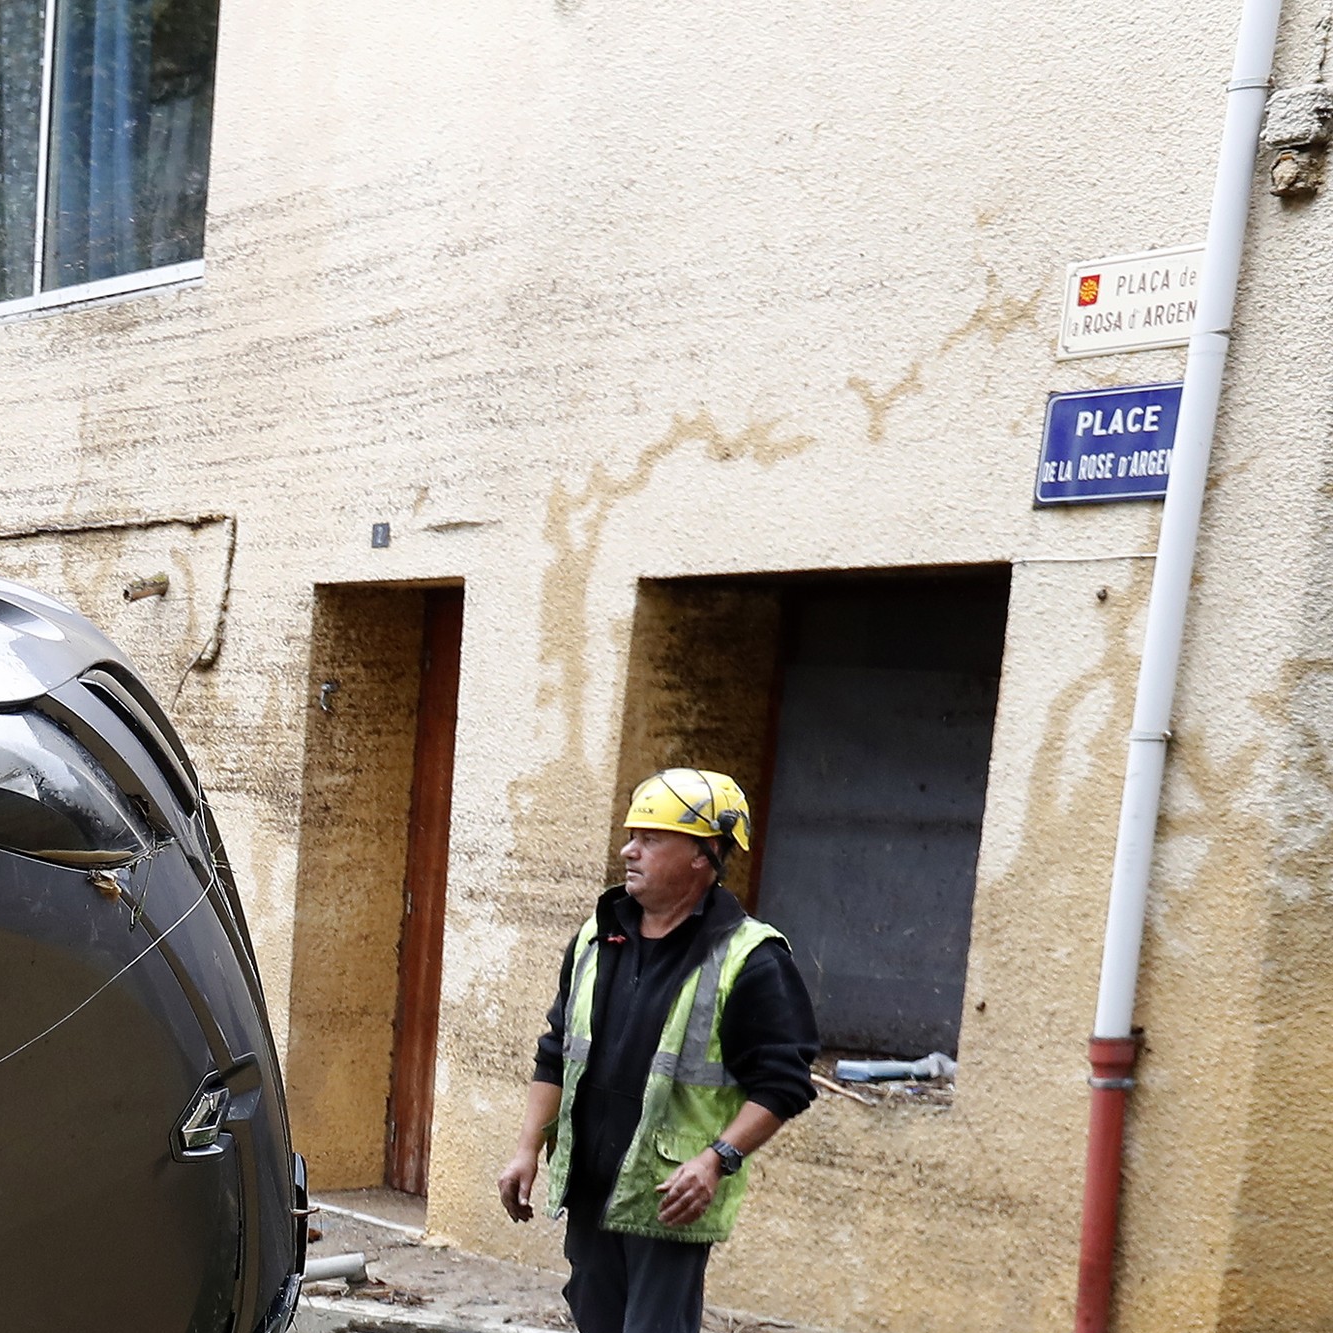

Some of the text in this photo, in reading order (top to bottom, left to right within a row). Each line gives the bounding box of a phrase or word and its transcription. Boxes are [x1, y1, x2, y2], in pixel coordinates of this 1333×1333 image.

[1179, 265, 1197, 288] de
[1082, 310, 1123, 336] ROSA
[1075, 404, 1163, 437] PLACE
[1041, 460, 1058, 483] DE
[1057, 459, 1073, 482] LA
[1077, 451, 1116, 481] ROSE
